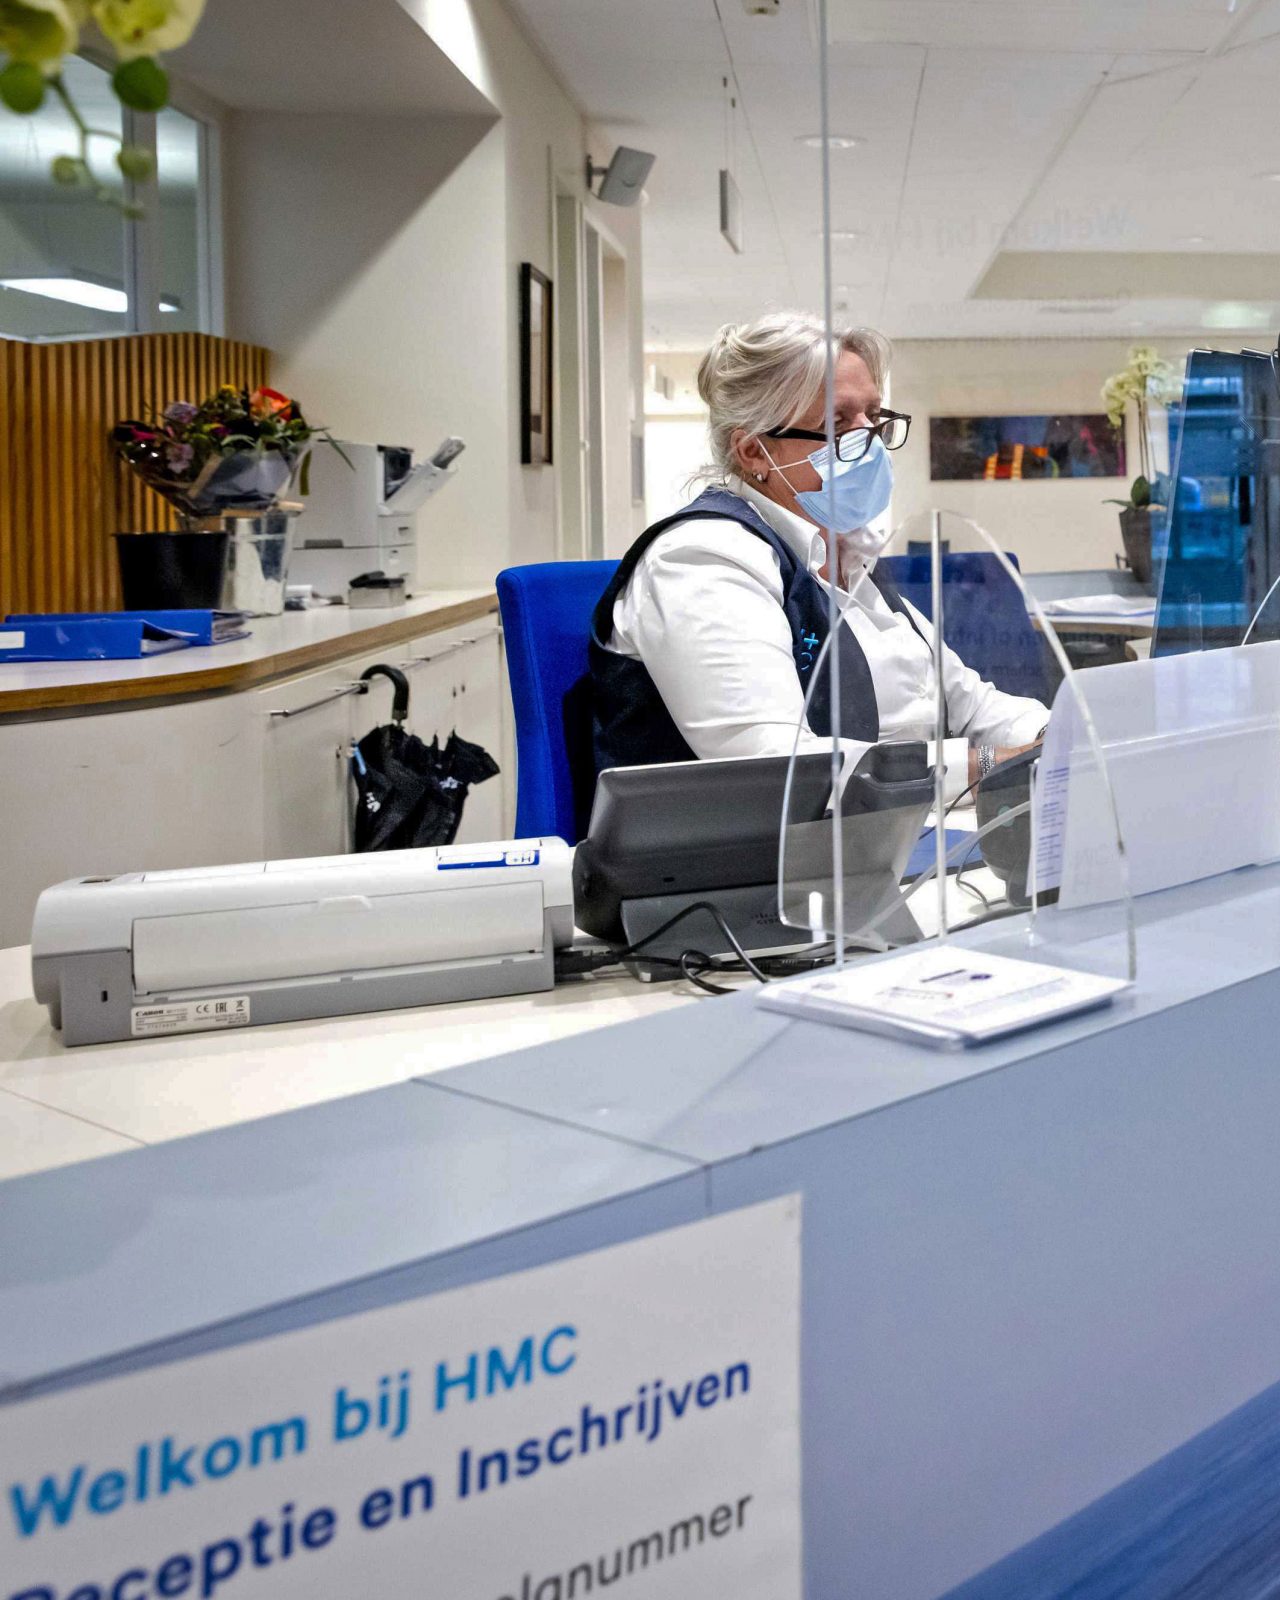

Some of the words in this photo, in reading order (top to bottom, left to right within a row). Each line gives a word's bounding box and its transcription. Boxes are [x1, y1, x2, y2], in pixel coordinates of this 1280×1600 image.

[8, 1416, 308, 1539] Welkom
[333, 1370, 411, 1443] bij
[434, 1324, 578, 1412] HMC
[358, 1474, 435, 1531] en
[457, 1361, 751, 1500] Inschrijven
[497, 1494, 753, 1600] lgnummer
